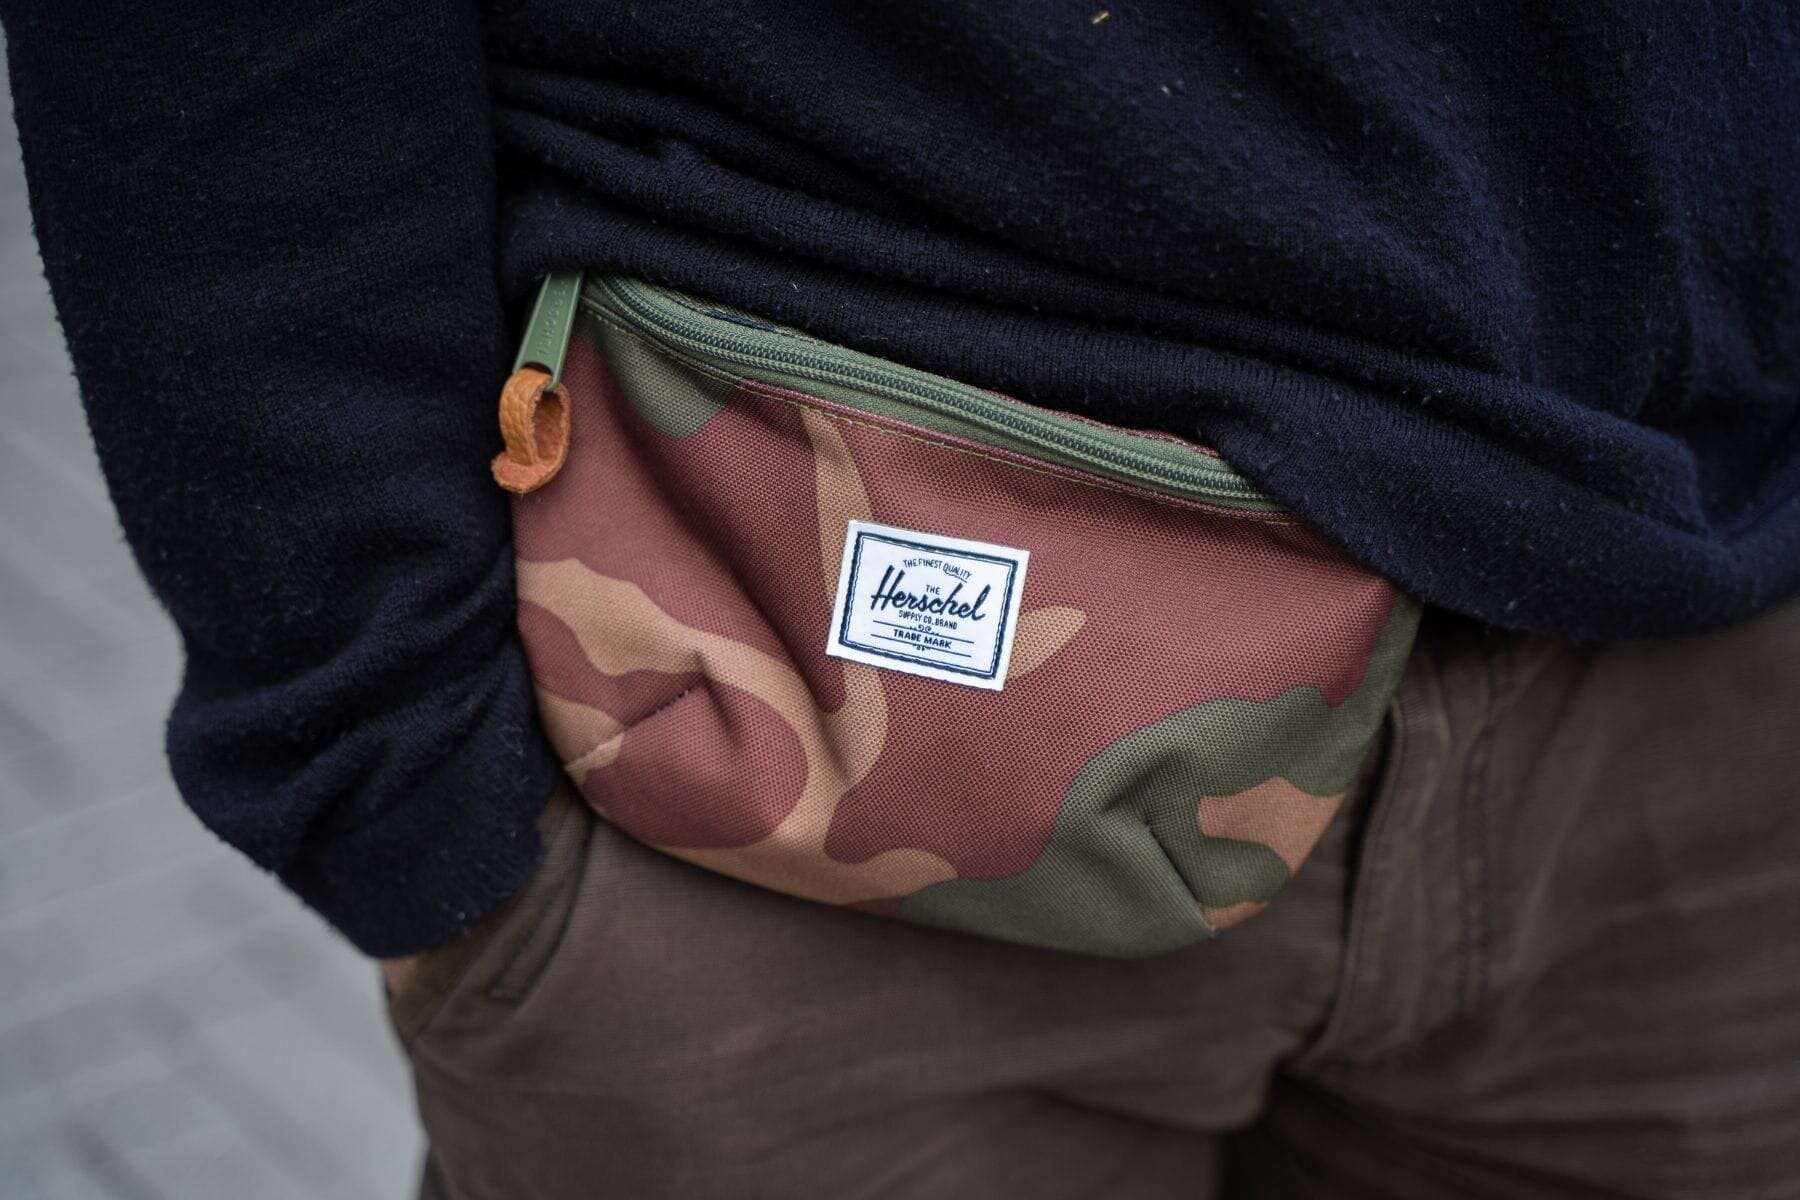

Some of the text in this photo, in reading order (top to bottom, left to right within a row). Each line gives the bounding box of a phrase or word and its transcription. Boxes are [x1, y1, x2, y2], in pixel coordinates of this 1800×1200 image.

[903, 558, 972, 582] THE FINEST QUALITY
[870, 564, 991, 622] Herschel
[926, 584, 941, 595] THE
[899, 610, 957, 630] SUPPLY CO. BRAND
[894, 628, 952, 649] TRADE MARK
